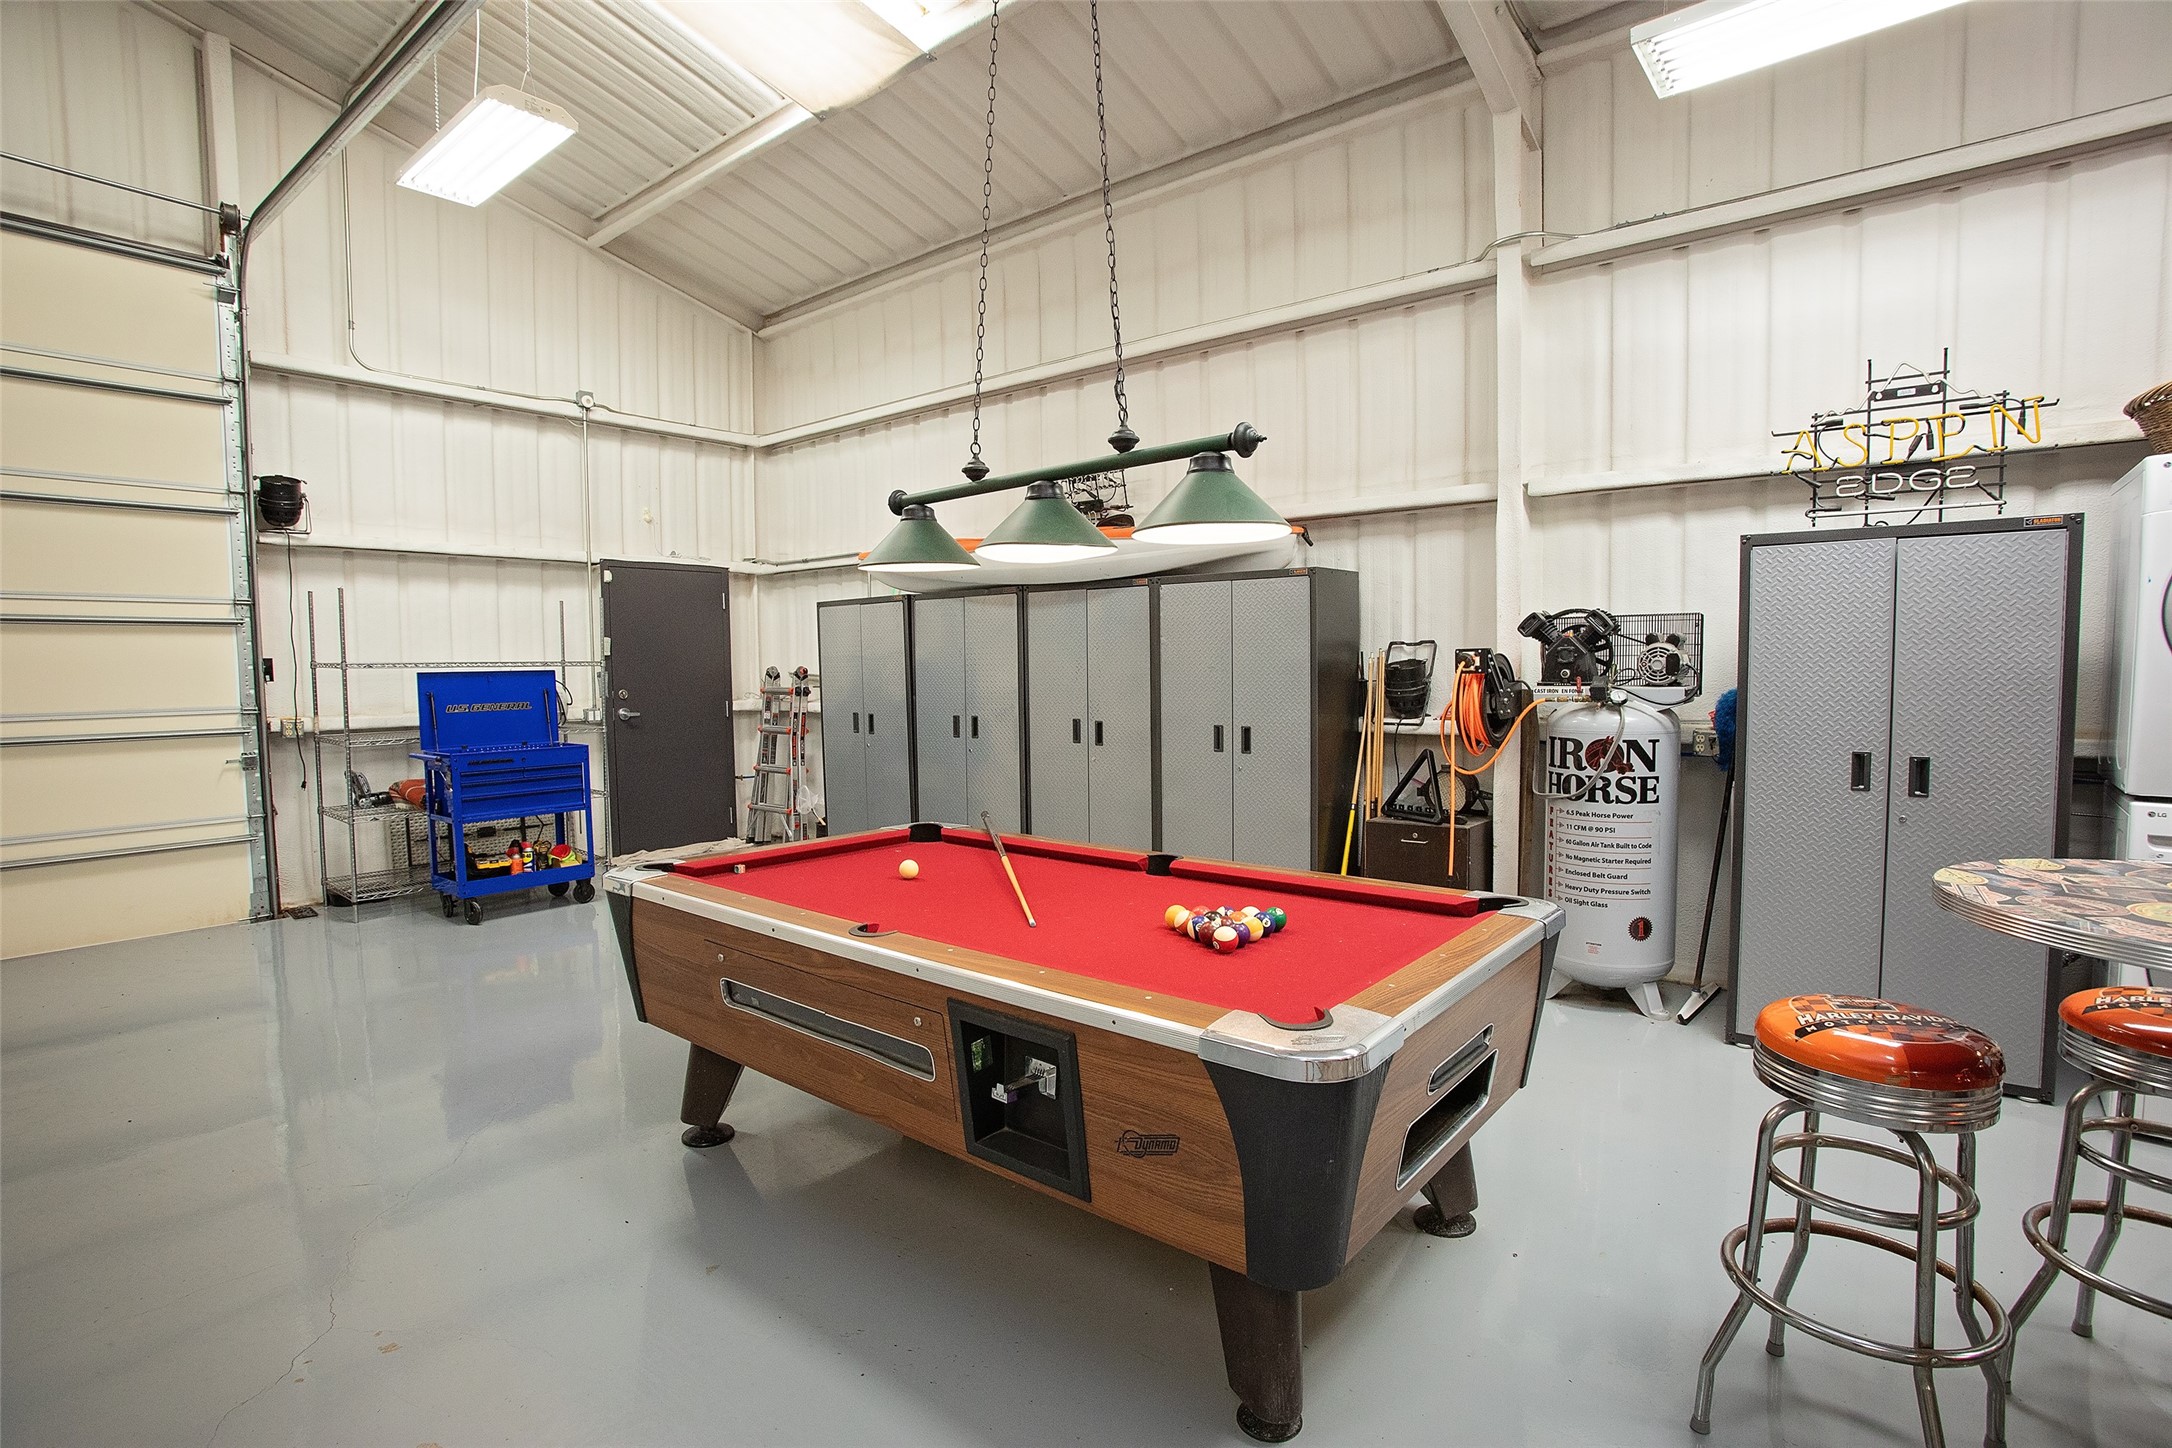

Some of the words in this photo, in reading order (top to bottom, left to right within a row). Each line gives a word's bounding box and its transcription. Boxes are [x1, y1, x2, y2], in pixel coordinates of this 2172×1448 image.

[1836, 465, 1979, 498] EDGE
[470, 701, 532, 713] GENERAL
[1549, 735, 1660, 775] IRON
[1549, 771, 1660, 804] HORSE
[1573, 824, 1587, 832] CFM
[1572, 839, 1590, 848] Gallon
[1573, 855, 1601, 863] Magnetic
[1624, 858, 1652, 866] Required
[1565, 868, 1591, 878] Enclosed
[1564, 883, 1583, 892] Heavy
[1583, 886, 1600, 894] Duty
[1564, 896, 1573, 904] Oil
[1573, 897, 1590, 907] Sight
[1637, 919, 1645, 937] 1
[1796, 1011, 1967, 1027] HARLEY-DAVIDS
